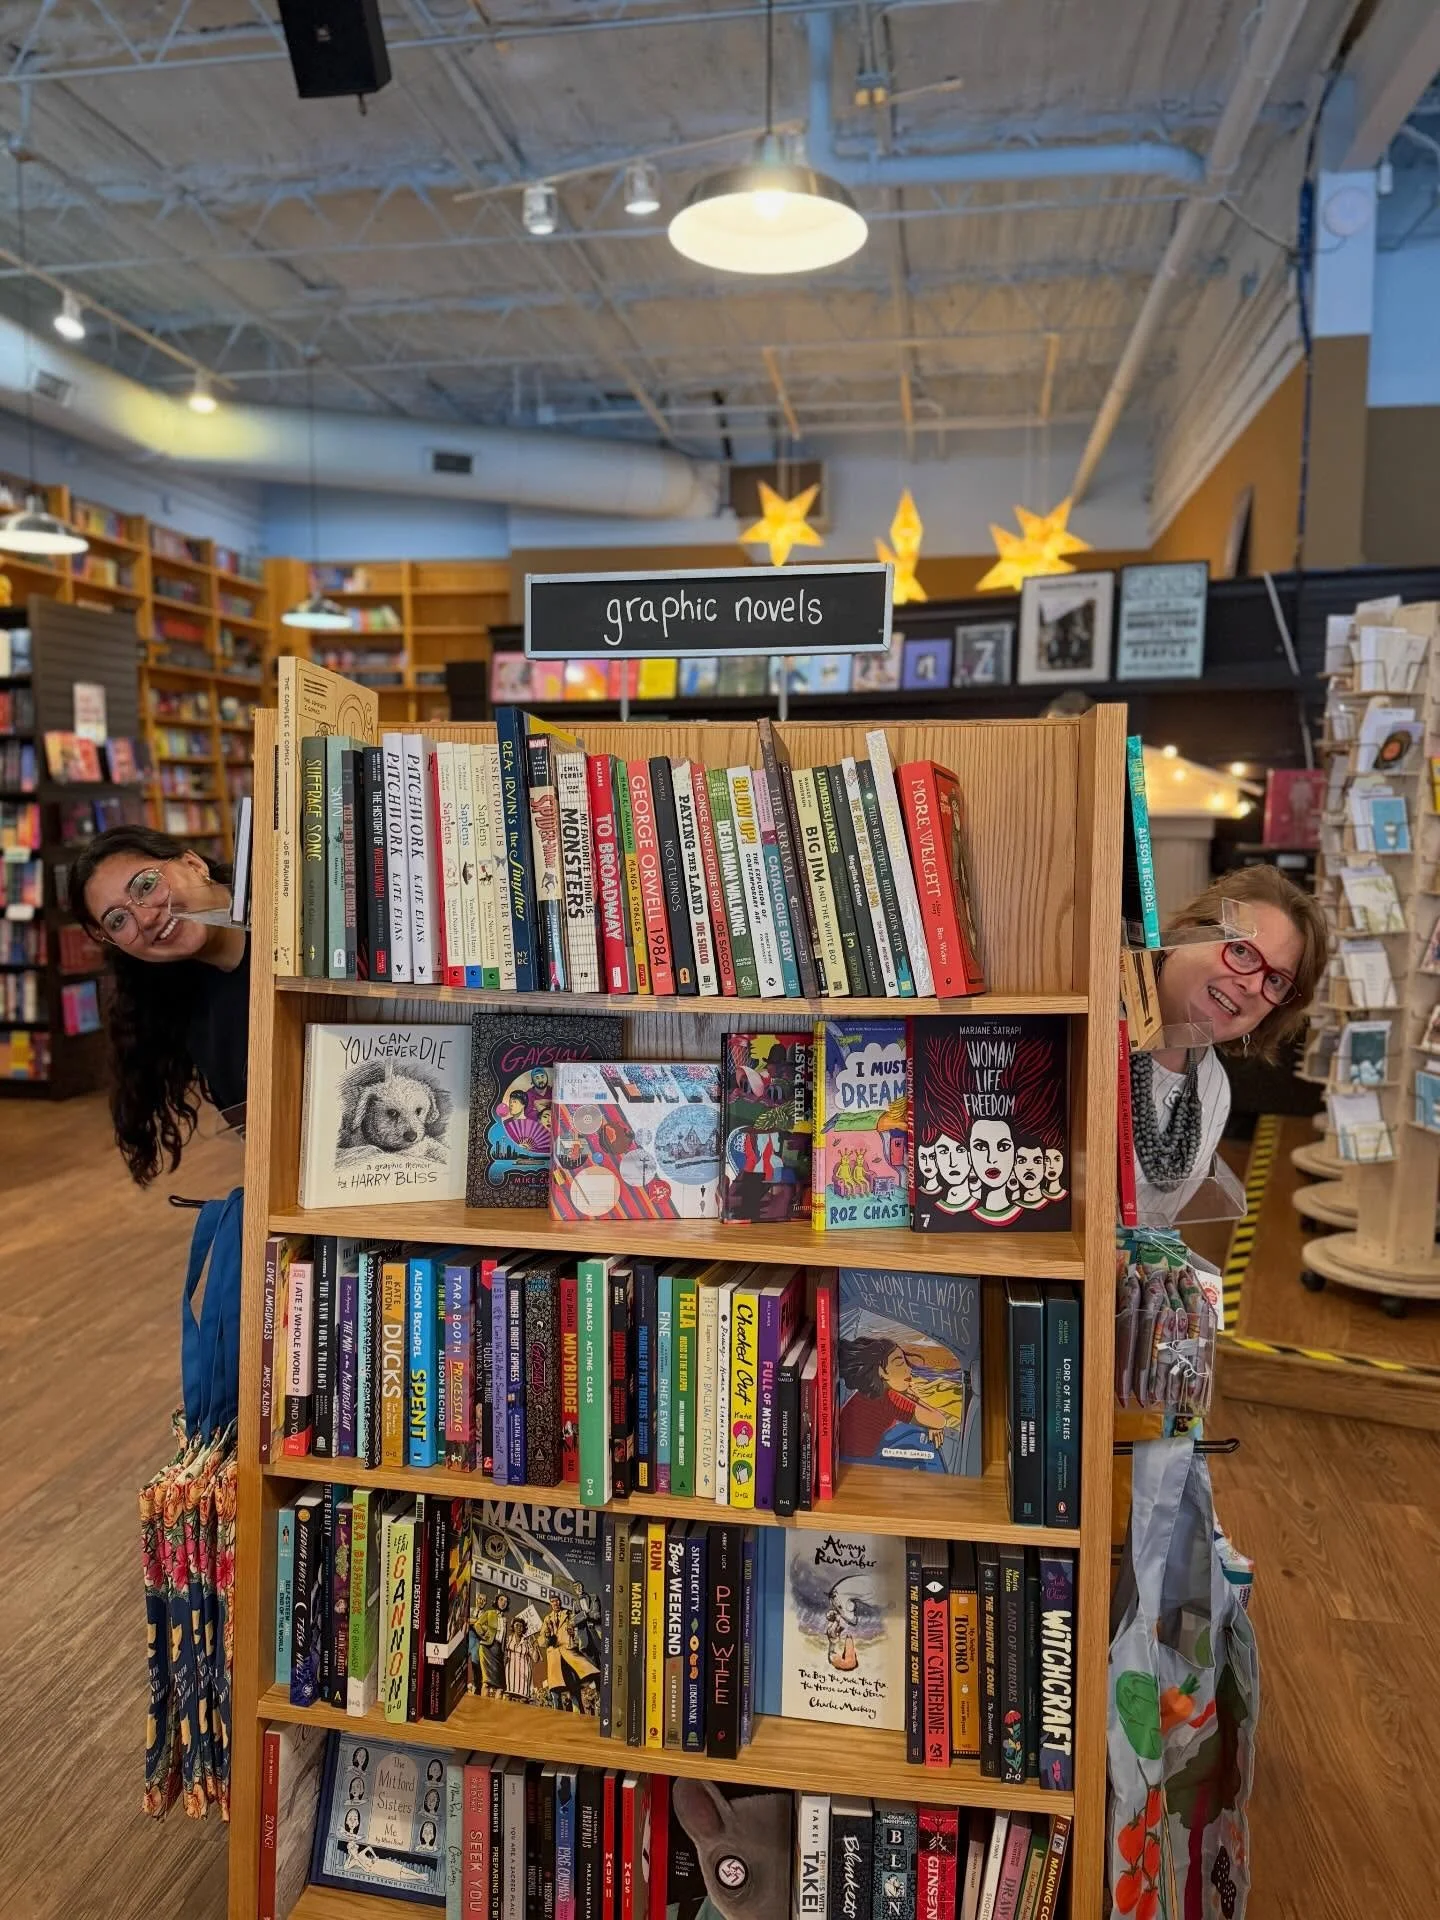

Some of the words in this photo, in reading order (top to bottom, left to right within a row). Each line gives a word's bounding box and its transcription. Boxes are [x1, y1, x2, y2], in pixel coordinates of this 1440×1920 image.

[603, 589, 718, 645] graphic
[735, 589, 823, 625] novels
[304, 759, 322, 818] SUFFRAGE
[695, 772, 705, 791] THE
[387, 752, 403, 858] PATCHWORK
[407, 753, 424, 859] PATCHWORK
[490, 751, 504, 847] INSECTOPOLIS
[631, 775, 654, 848] GEORGE
[698, 794, 708, 823] ONCE
[770, 787, 784, 816] THE
[817, 772, 839, 854] LUMBERJANES
[580, 813, 588, 826] MY
[595, 813, 611, 837] TO
[678, 794, 696, 850] PAYING
[702, 825, 711, 847] AND
[717, 819, 733, 851] DEAD
[306, 824, 323, 862] SONG
[581, 828, 591, 873] FAVORITE
[776, 821, 795, 883] ARRIVAL
[805, 826, 821, 855] BIG
[1138, 827, 1147, 865] ALISON
[561, 807, 585, 920] MONSTERS
[628, 859, 637, 891] MANGA
[664, 839, 682, 912] NOCTURNOS
[688, 852, 697, 872] THE
[705, 848, 717, 888] FUTURE
[722, 852, 737, 881] MAN
[809, 857, 826, 882] JIM
[391, 872, 402, 903] KATE
[413, 874, 424, 904] KATE
[499, 877, 509, 918] PETER
[583, 875, 592, 903] THING
[598, 842, 622, 941] BROADWAY
[641, 857, 662, 923] ORWELL
[688, 874, 704, 915] LAND
[711, 890, 721, 913] RIOT
[817, 885, 826, 901] AND
[1142, 868, 1153, 913] BECHDEL
[393, 908, 404, 942] EVANS
[585, 905, 593, 914] IS
[631, 896, 641, 932] STORIES
[728, 881, 746, 937] WALKING
[768, 855, 785, 929] CATALOGUE
[780, 931, 793, 962] BABY
[821, 903, 830, 919] THE
[415, 910, 425, 943] EVANS
[695, 921, 706, 937] JOE
[715, 919, 724, 937] JOE
[824, 921, 834, 947] WHITE
[502, 925, 513, 967] KUPER
[650, 927, 667, 966] 1984
[697, 938, 709, 965] SACCO
[718, 940, 731, 975] SACCO
[828, 949, 837, 965] BOY
[378, 1032, 411, 1045] CAN
[959, 1026, 990, 1035] MARJANE
[992, 1026, 1022, 1035] SATRAPI
[339, 1035, 372, 1070] YOU
[374, 1045, 418, 1058] NEVER
[419, 1036, 453, 1070] DIE
[794, 1042, 805, 1085] PAST
[966, 1040, 1017, 1069] WOMAN
[975, 1069, 1003, 1093] LIFE
[794, 1087, 804, 1123] THE
[963, 1093, 1016, 1117] FREEDOM
[337, 1177, 347, 1189] by
[351, 1174, 391, 1192] HARRY
[395, 1171, 438, 1186] BLISS
[830, 1205, 857, 1224] ROZ
[863, 1203, 909, 1218] CHAST
[319, 1280, 329, 1299] THE
[384, 1274, 393, 1312] BEATON
[393, 1281, 401, 1306] KATE
[413, 1269, 423, 1310] ALISON
[452, 1275, 462, 1310] TARA
[510, 1289, 519, 1319] MURDER
[851, 1271, 868, 1291] IT
[872, 1274, 914, 1297] WON'T
[917, 1279, 975, 1314] ALWAYS
[318, 1301, 329, 1320] NEW
[658, 1311, 671, 1337] FINE
[861, 1290, 875, 1308] BE
[885, 1298, 922, 1325] LIKE
[928, 1306, 972, 1345] THIS
[318, 1323, 328, 1348] YORK
[413, 1311, 422, 1358] BECHDEL
[452, 1313, 462, 1353] BOOTH
[511, 1326, 519, 1350] ORIENT
[736, 1303, 753, 1366] Checked
[316, 1350, 328, 1390] TRILOGY
[382, 1323, 401, 1401] DUCKS
[438, 1349, 446, 1386] ALISON
[510, 1352, 520, 1382] EXPRESS
[586, 1340, 594, 1372] ACTING
[1020, 1343, 1035, 1366] THE
[1062, 1358, 1072, 1382] LORD
[563, 1332, 578, 1414] MUYBRIDGE
[586, 1375, 594, 1404] CLASS
[736, 1369, 754, 1406] Out
[762, 1360, 773, 1391] FULL
[1063, 1384, 1071, 1396] OF
[291, 1397, 300, 1420] FIND
[410, 1368, 427, 1443] SPENT
[438, 1387, 446, 1432] BECHDEL
[452, 1360, 464, 1433] PROCESSING
[659, 1378, 668, 1407] RHEA
[763, 1392, 771, 1405] OF
[1020, 1367, 1036, 1419] PROPHET
[1063, 1398, 1071, 1413] THE
[289, 1421, 299, 1441] YOU
[659, 1409, 668, 1447] EWING
[760, 1407, 771, 1448] MYSELF
[1062, 1416, 1072, 1440] FLIES
[482, 1500, 597, 1538] MARCH
[546, 1534, 574, 1543] COMPLETE
[574, 1537, 596, 1546] TRILOGY
[821, 1534, 866, 1558] Always
[668, 1543, 685, 1576] Boys
[814, 1548, 878, 1568] Remember
[474, 1561, 529, 1592] ETTUS
[911, 1585, 919, 1601] THE
[412, 1583, 421, 1629] DESTROYER
[631, 1582, 641, 1625] MARCH
[667, 1577, 683, 1655] WEEKEND
[388, 1554, 407, 1702] CANNON
[911, 1603, 919, 1652] ADVENTURE
[926, 1609, 943, 1652] SAINT
[953, 1614, 971, 1674] TOTORO
[911, 1655, 919, 1685] ZONE
[927, 1655, 945, 1735] CATHERINE
[393, 1756, 405, 1768] The
[377, 1770, 415, 1792] Mitford
[376, 1791, 413, 1814] Sisters
[263, 1813, 275, 1849] ZONG!
[384, 1824, 398, 1837] Me
[581, 1805, 592, 1849] PERSEPOLIS
[811, 1809, 819, 1844] TAKEI
[469, 1830, 483, 1872] SEEK
[802, 1851, 819, 1913] TAKEI
[842, 1834, 862, 1919] Blankets
[1043, 1856, 1059, 1904] MAKING
[469, 1879, 483, 1913] YOU
[492, 1896, 498, 1908] TO
